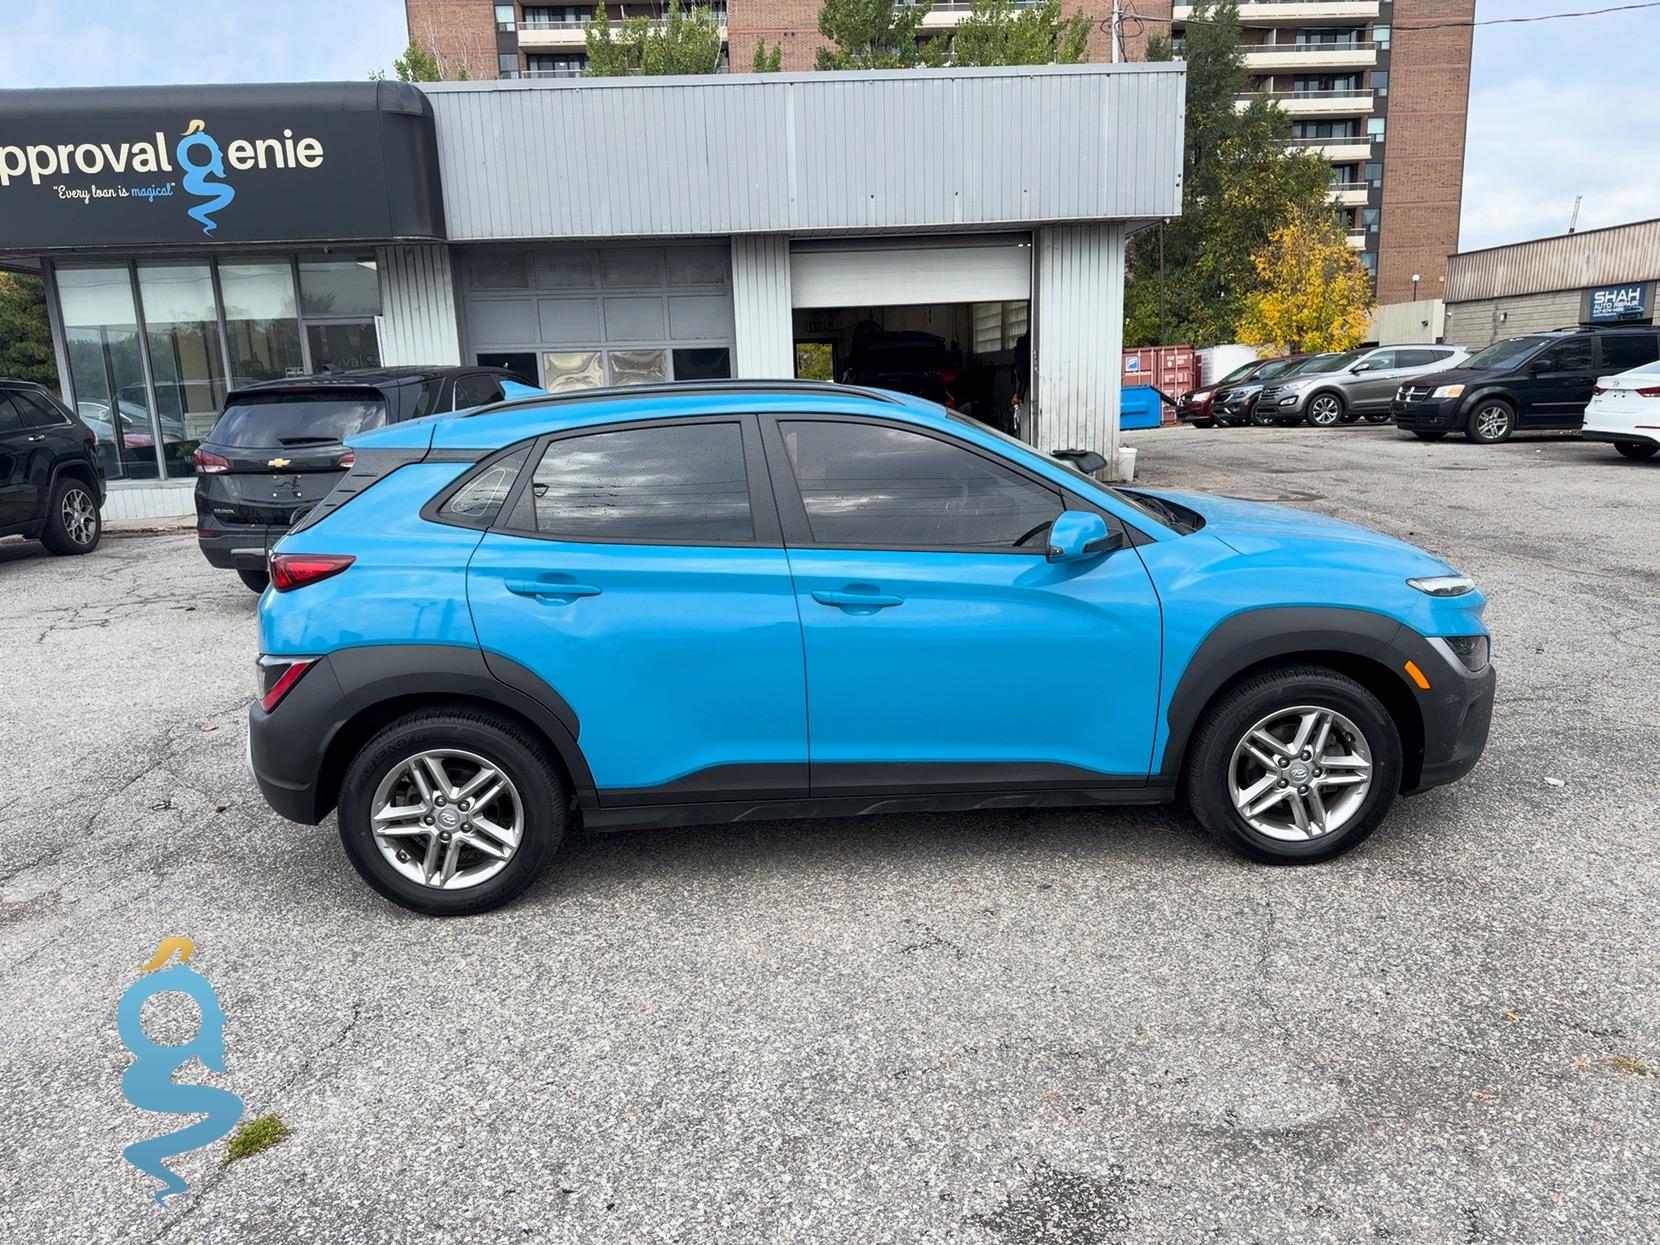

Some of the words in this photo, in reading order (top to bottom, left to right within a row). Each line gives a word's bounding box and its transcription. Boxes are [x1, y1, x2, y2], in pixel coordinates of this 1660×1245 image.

[91, 184, 117, 198] loan
[117, 185, 130, 198] is
[1594, 287, 1641, 304] SHAH
